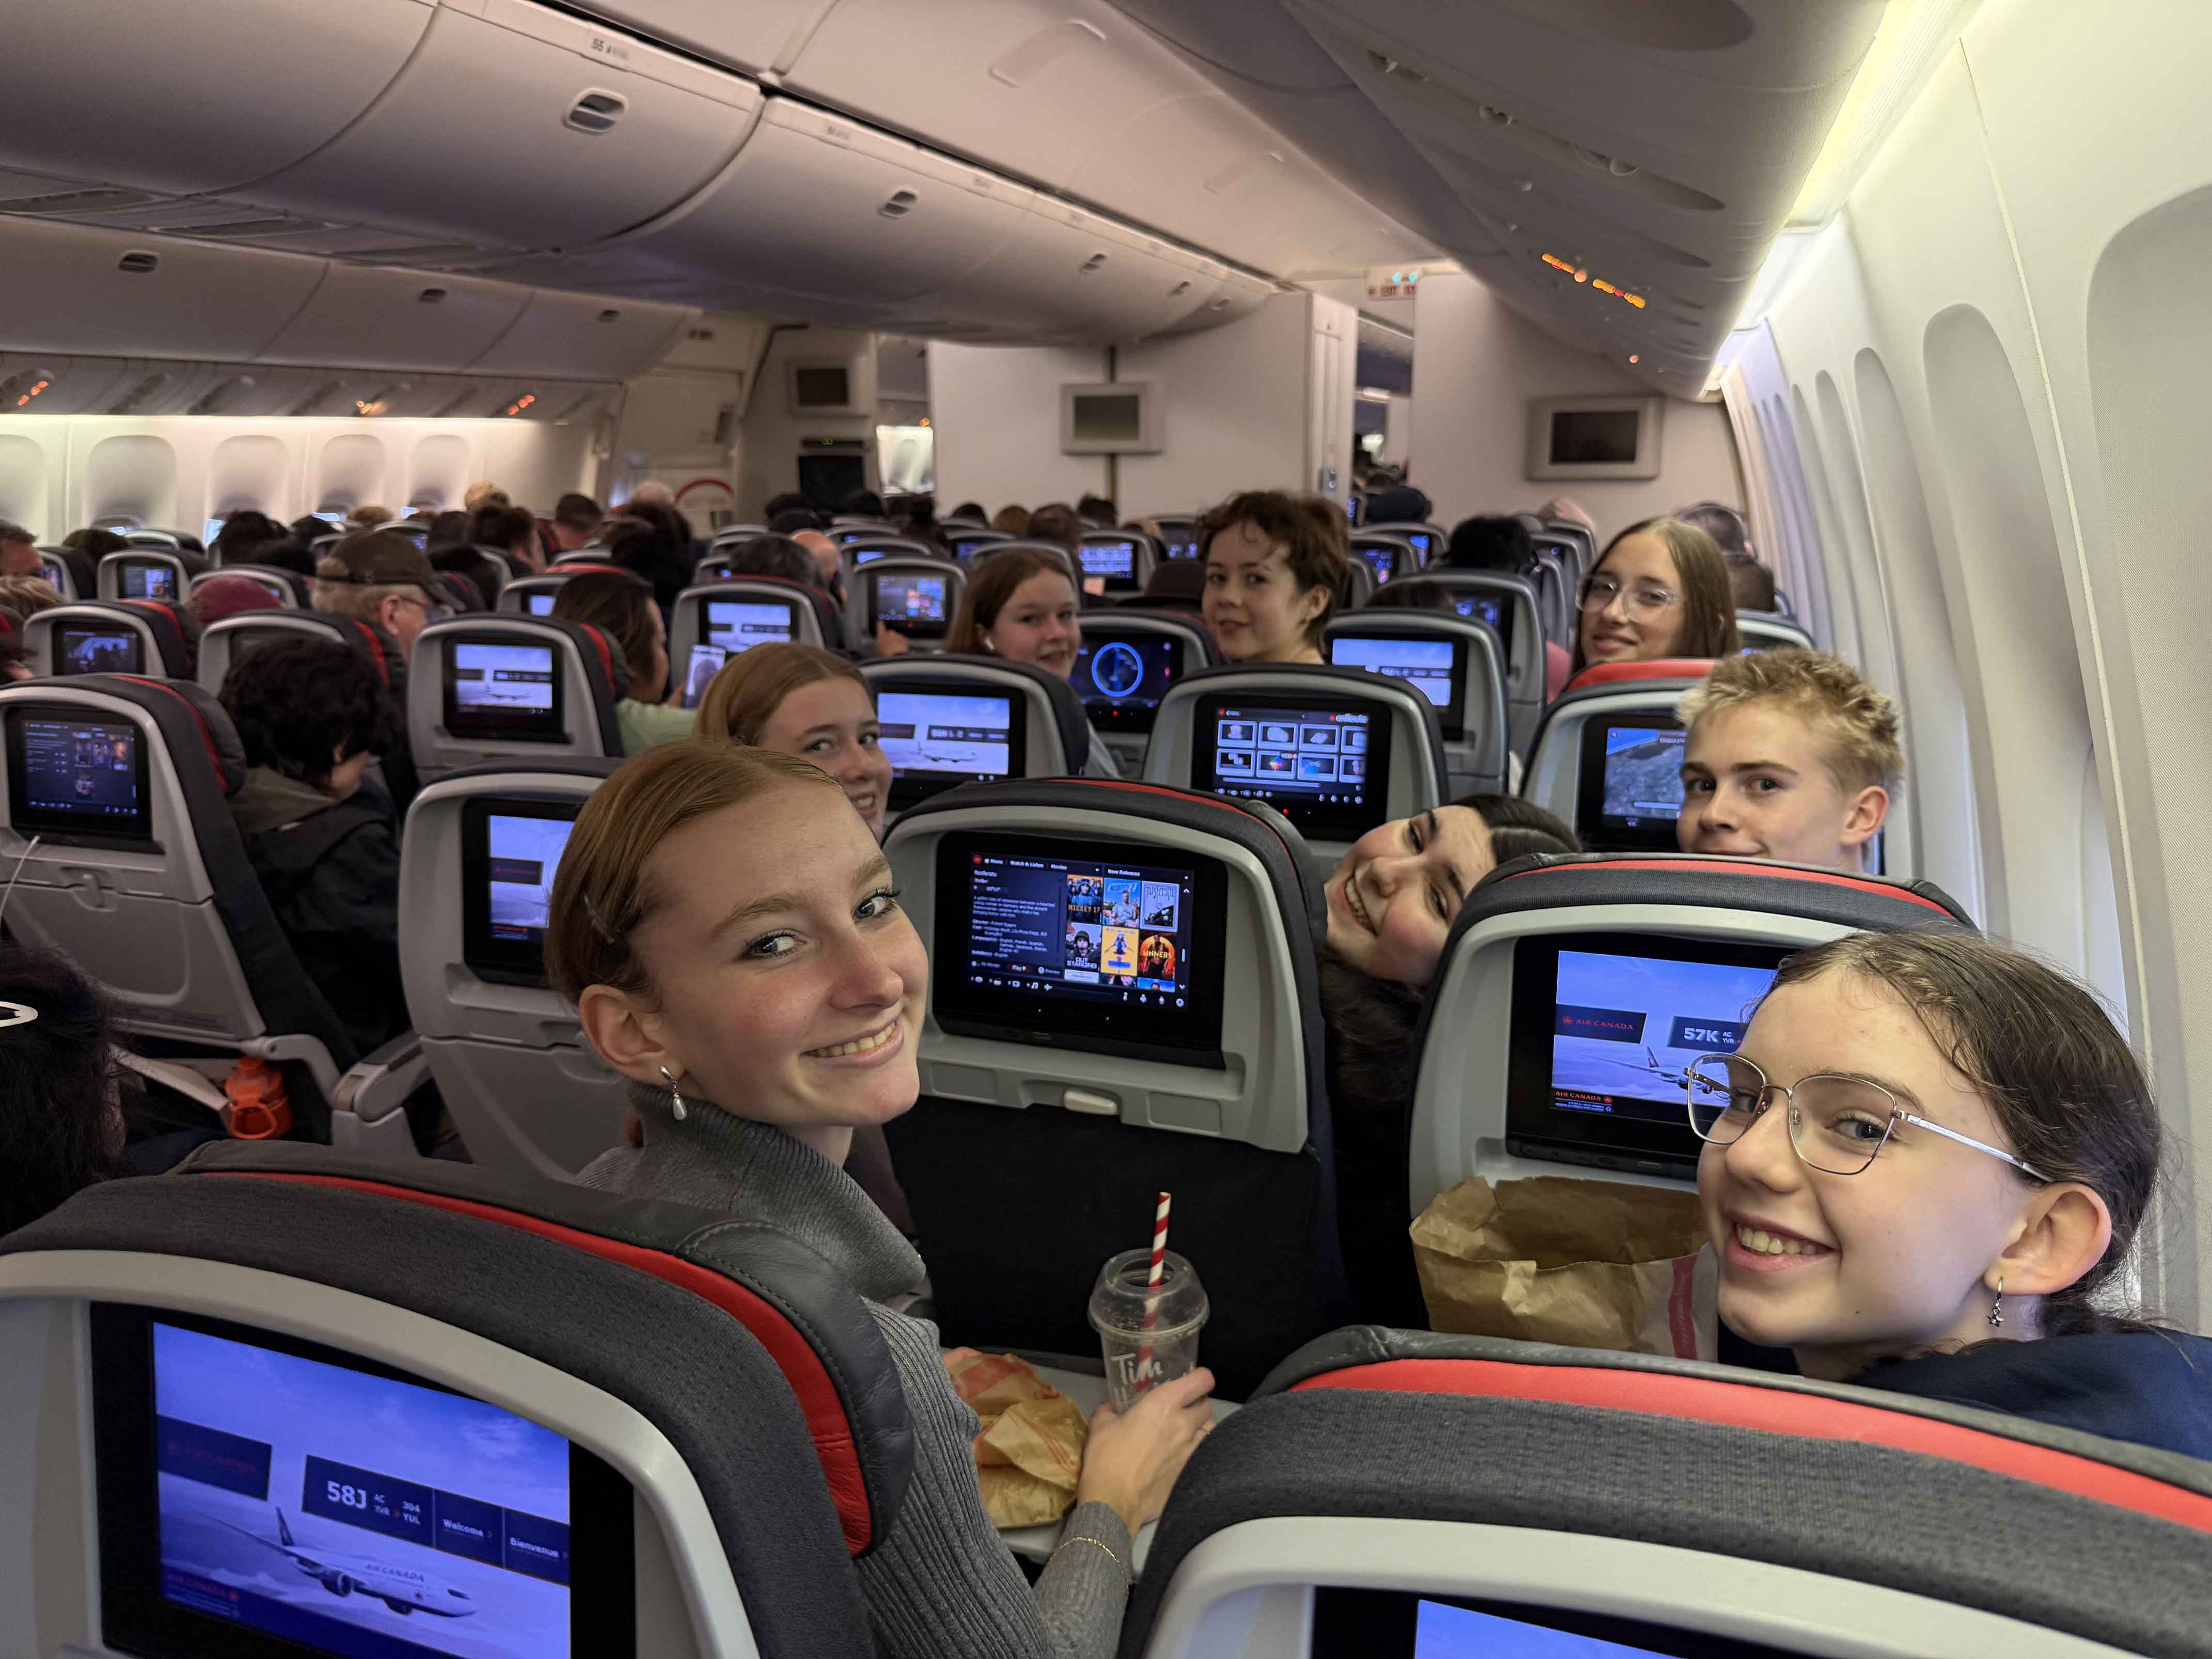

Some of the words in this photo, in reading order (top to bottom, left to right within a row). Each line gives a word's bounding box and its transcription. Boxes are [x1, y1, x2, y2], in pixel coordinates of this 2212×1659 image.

[1143, 950, 1171, 959] SINNERS
[1594, 1020, 1634, 1031] CANADA
[1684, 1028, 1718, 1043] 57K
[1570, 1093, 1601, 1102] CANADA
[1111, 1352, 1164, 1385] Tim
[327, 1480, 367, 1510] 58J
[373, 1493, 386, 1504] AC
[403, 1500, 421, 1512] 304
[403, 1512, 421, 1525] YUL
[443, 1519, 484, 1537] Welcome
[510, 1537, 559, 1558] Bienvenue
